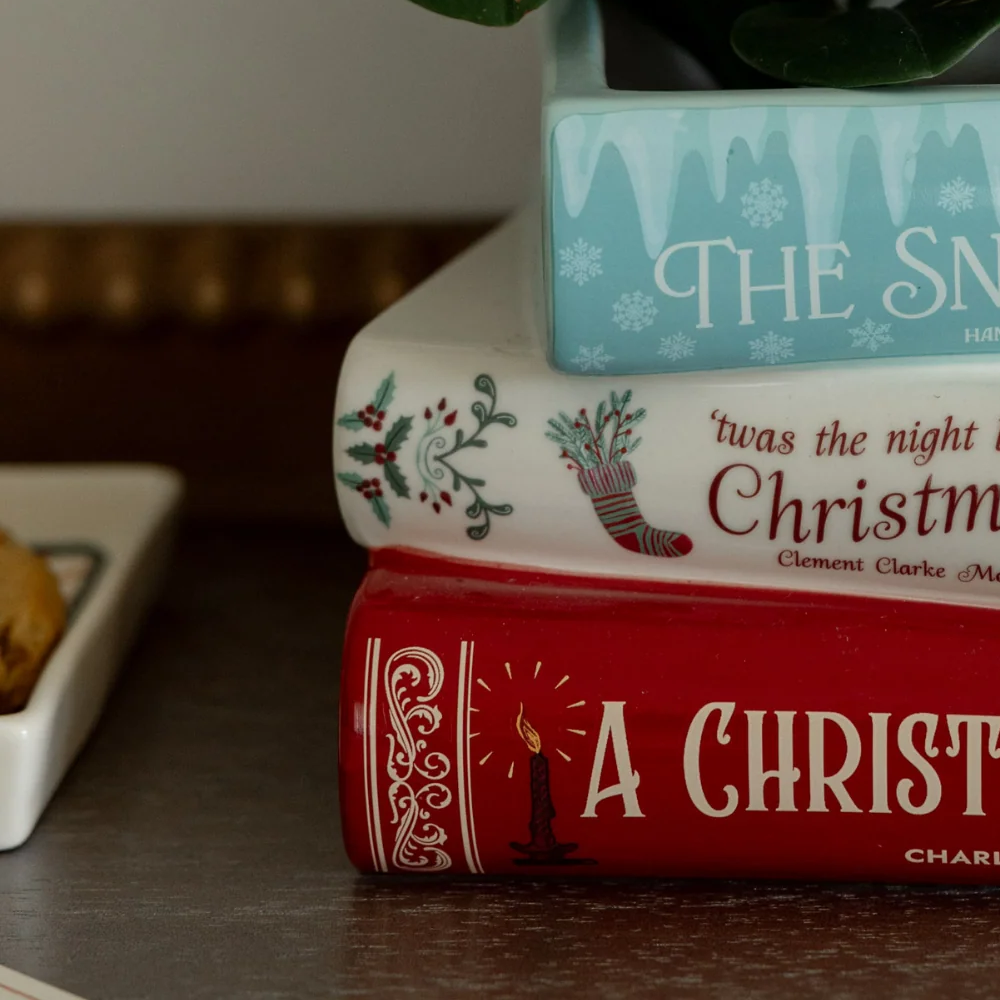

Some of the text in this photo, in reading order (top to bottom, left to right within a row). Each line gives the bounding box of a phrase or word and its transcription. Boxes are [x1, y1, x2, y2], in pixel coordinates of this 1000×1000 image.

[654, 236, 855, 329] THE
[815, 419, 868, 456] the
[886, 415, 979, 466] night
[777, 550, 865, 573] Clement
[875, 556, 946, 579] Clarke
[580, 701, 645, 818] A
